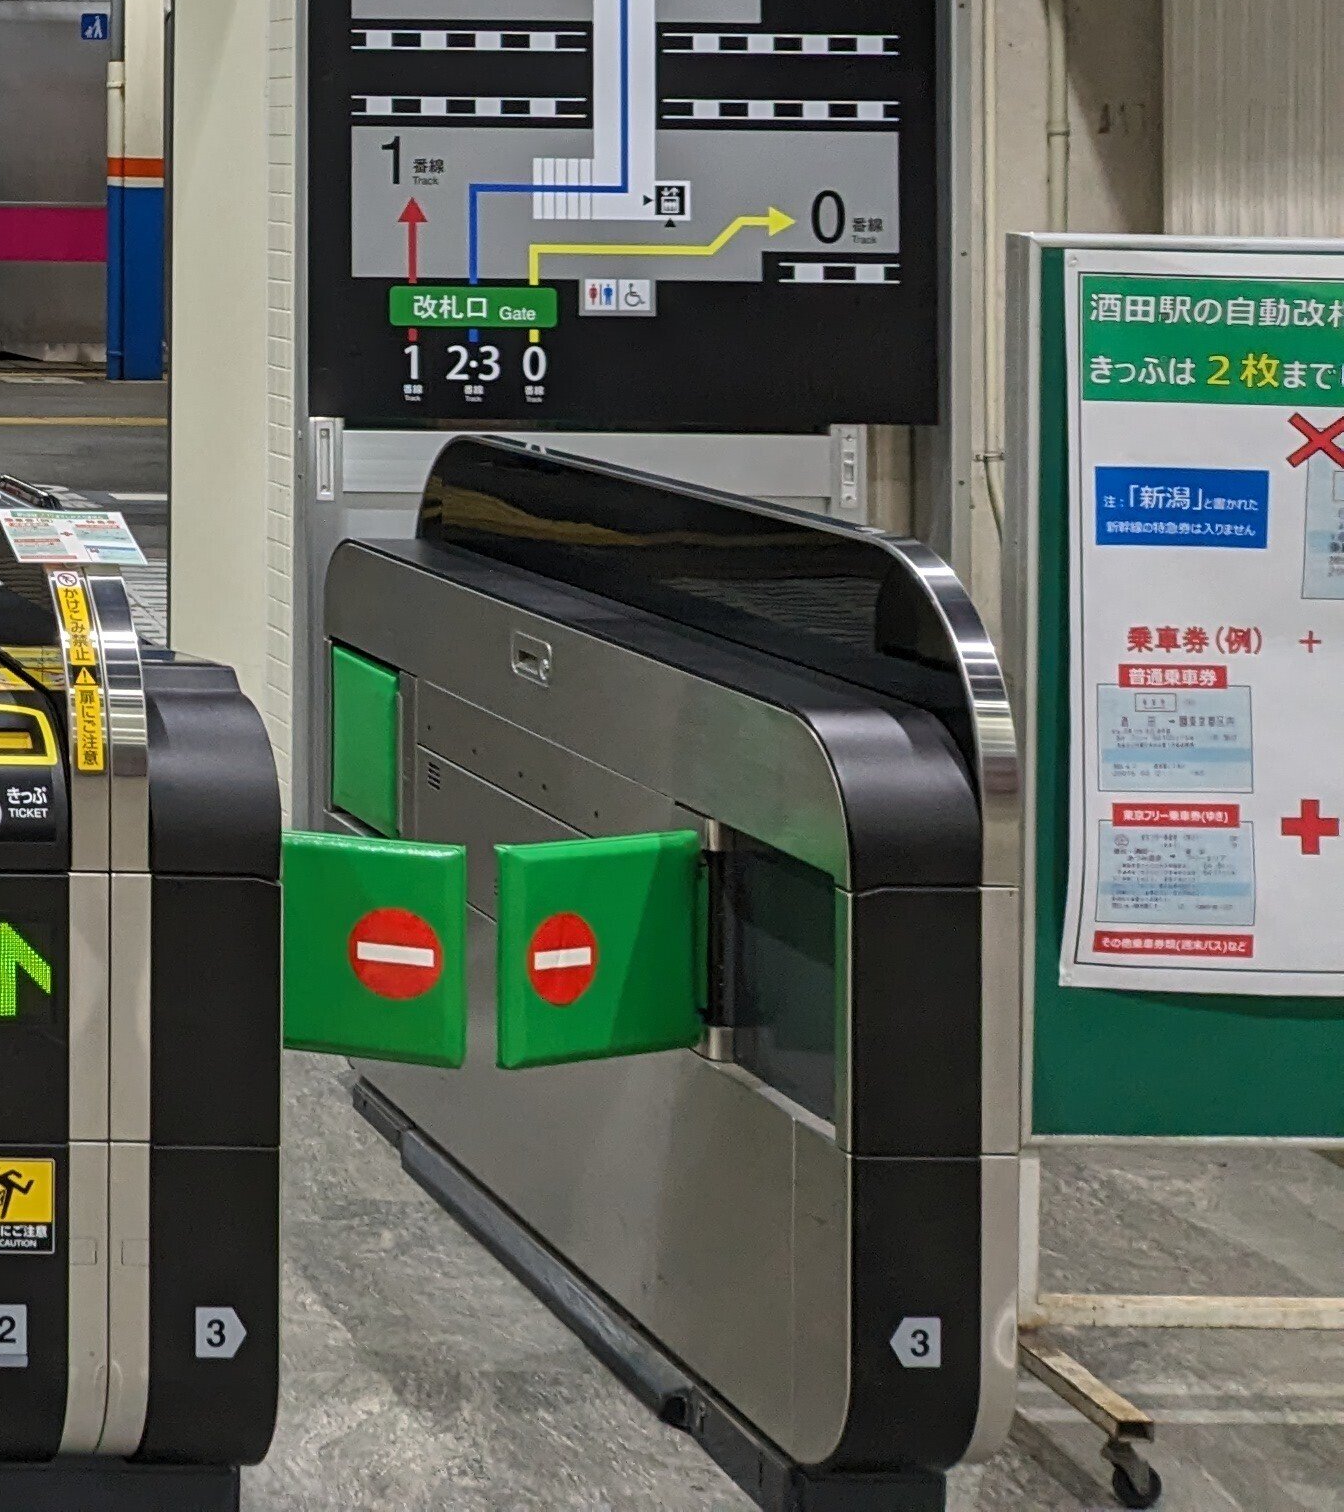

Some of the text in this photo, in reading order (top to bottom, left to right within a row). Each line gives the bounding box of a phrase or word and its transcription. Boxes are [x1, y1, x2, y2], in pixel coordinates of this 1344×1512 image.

[381, 136, 444, 185] 1 番線
[812, 190, 883, 244] 0 番線
[413, 295, 536, 320] 改札口 Gate
[404, 345, 419, 380] 1
[522, 346, 547, 381] 0
[7, 787, 48, 804] きっぷ
[8, 808, 48, 819] TICKET
[0, 1239, 37, 1248] CAUTION
[206, 1319, 226, 1347] 3
[911, 1329, 929, 1357] 3
